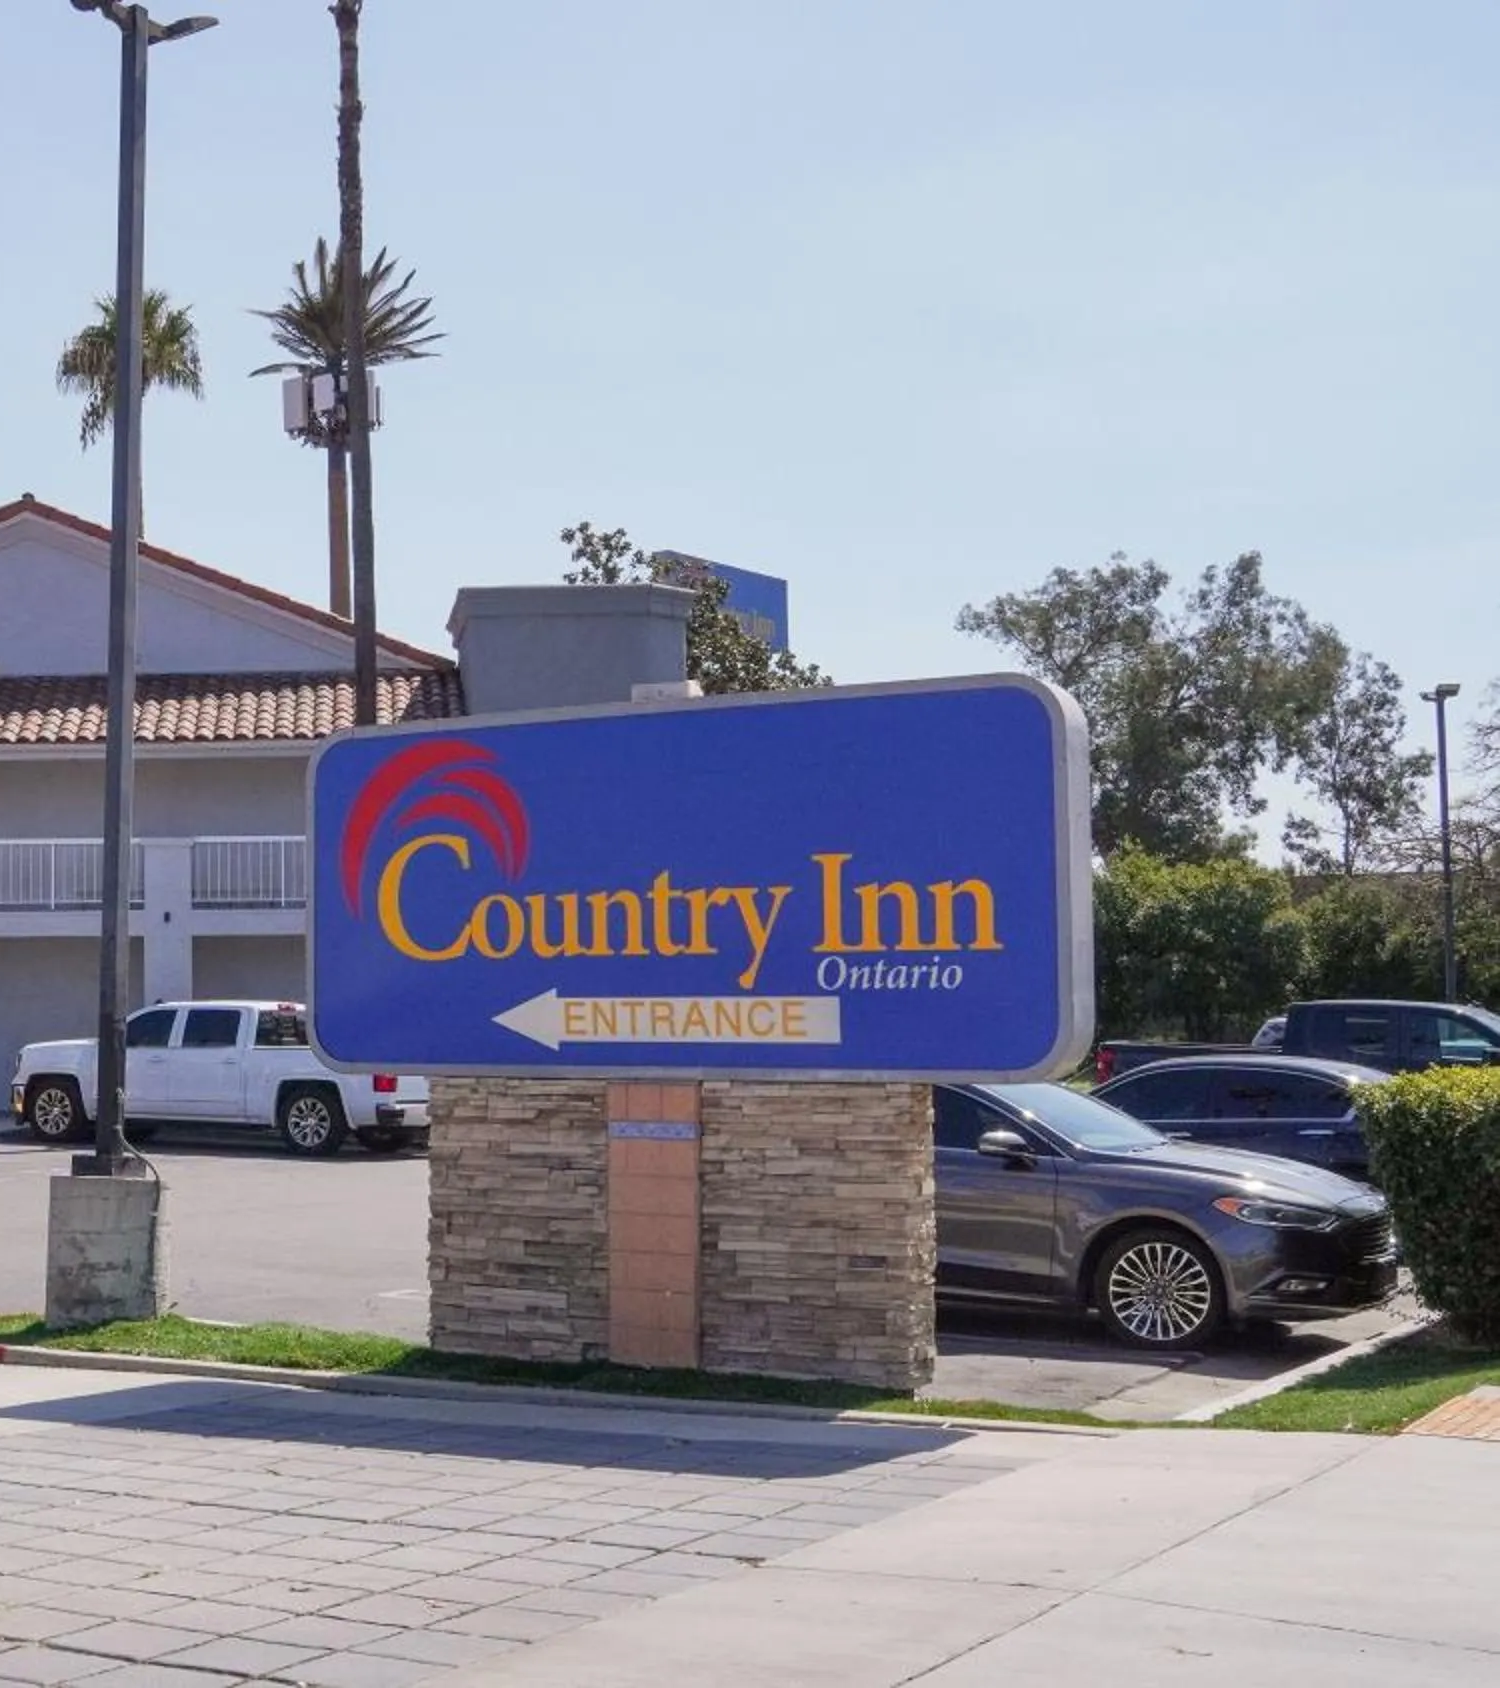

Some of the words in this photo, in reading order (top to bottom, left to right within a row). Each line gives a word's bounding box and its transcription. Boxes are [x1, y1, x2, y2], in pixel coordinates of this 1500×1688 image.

[377, 834, 791, 989] Country
[811, 853, 1003, 952] Inn
[817, 955, 963, 990] Ontario
[563, 1001, 808, 1038] ENTRANCE
